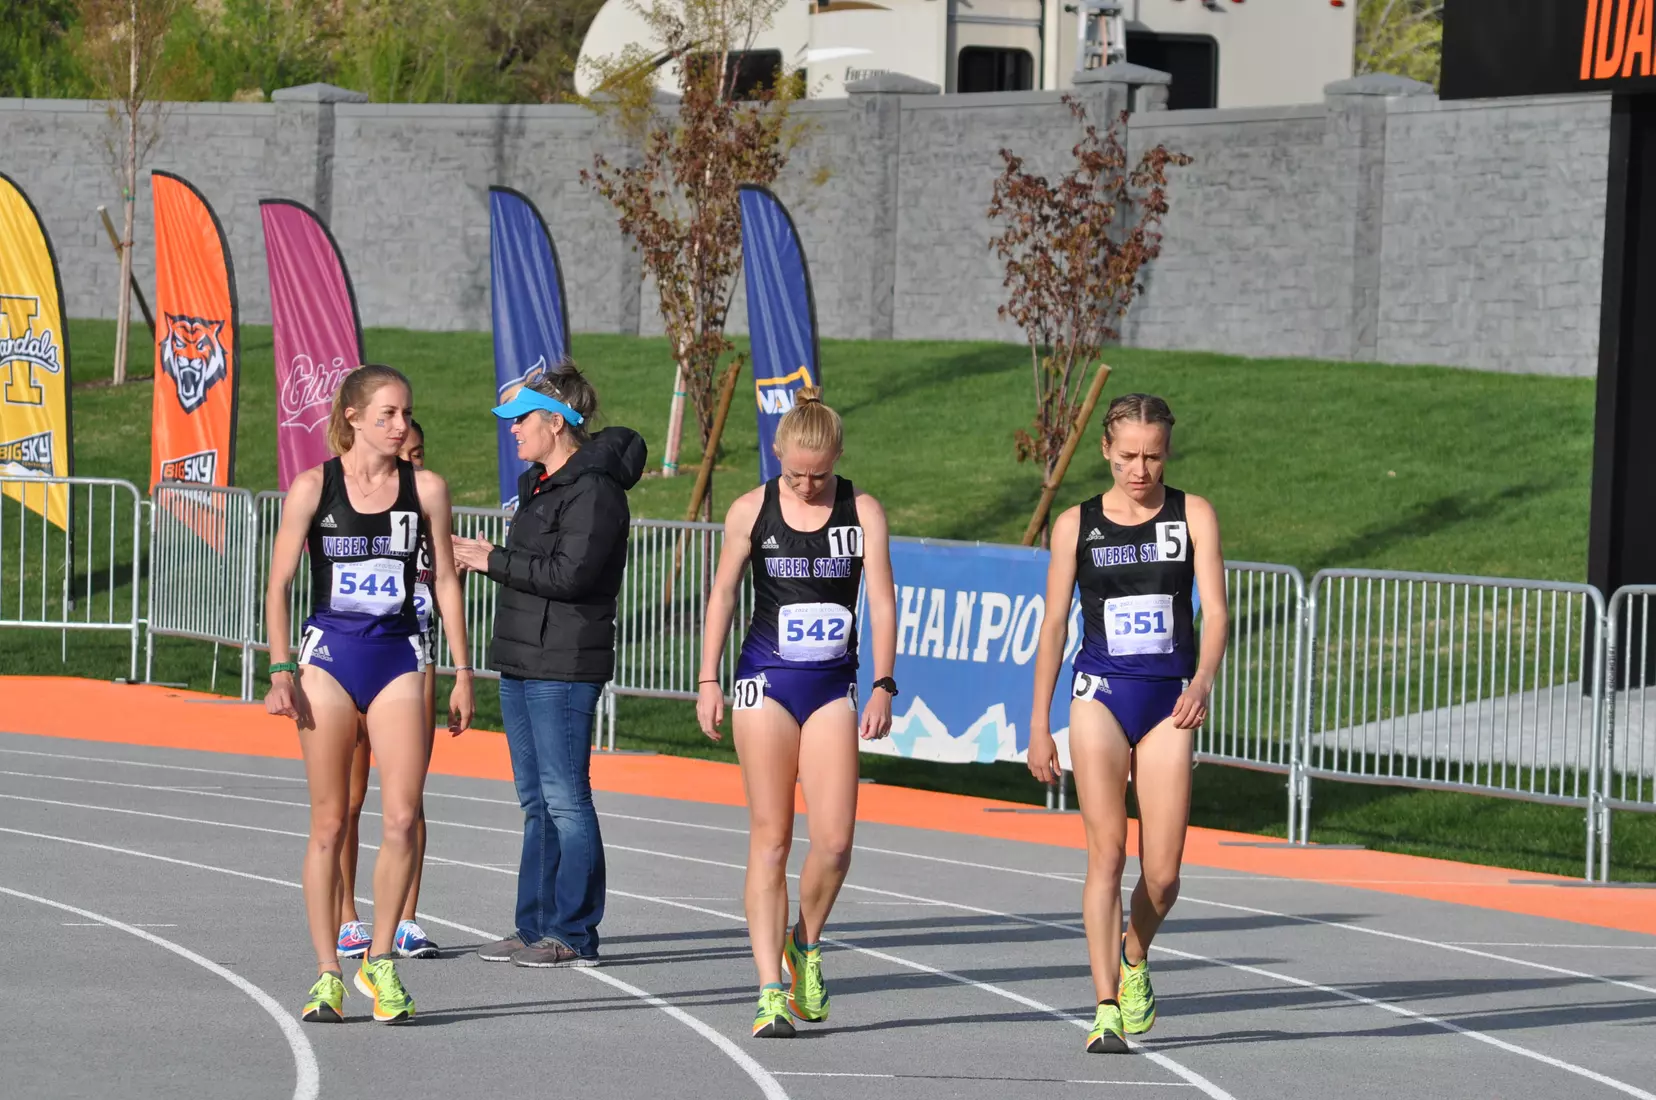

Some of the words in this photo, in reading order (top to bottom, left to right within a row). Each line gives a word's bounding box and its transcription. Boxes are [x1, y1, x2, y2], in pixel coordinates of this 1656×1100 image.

[1580, 0, 1656, 80] IDA
[399, 514, 410, 550] 1
[832, 528, 857, 556] 10
[1165, 525, 1181, 559] 5
[322, 536, 368, 557] WEBER
[1092, 544, 1138, 567] WEBER
[765, 557, 810, 578] WEBER
[813, 557, 851, 578] STATE
[339, 572, 399, 597] 544
[787, 618, 845, 642] 542
[1115, 611, 1167, 635] 551
[736, 680, 758, 707] 10
